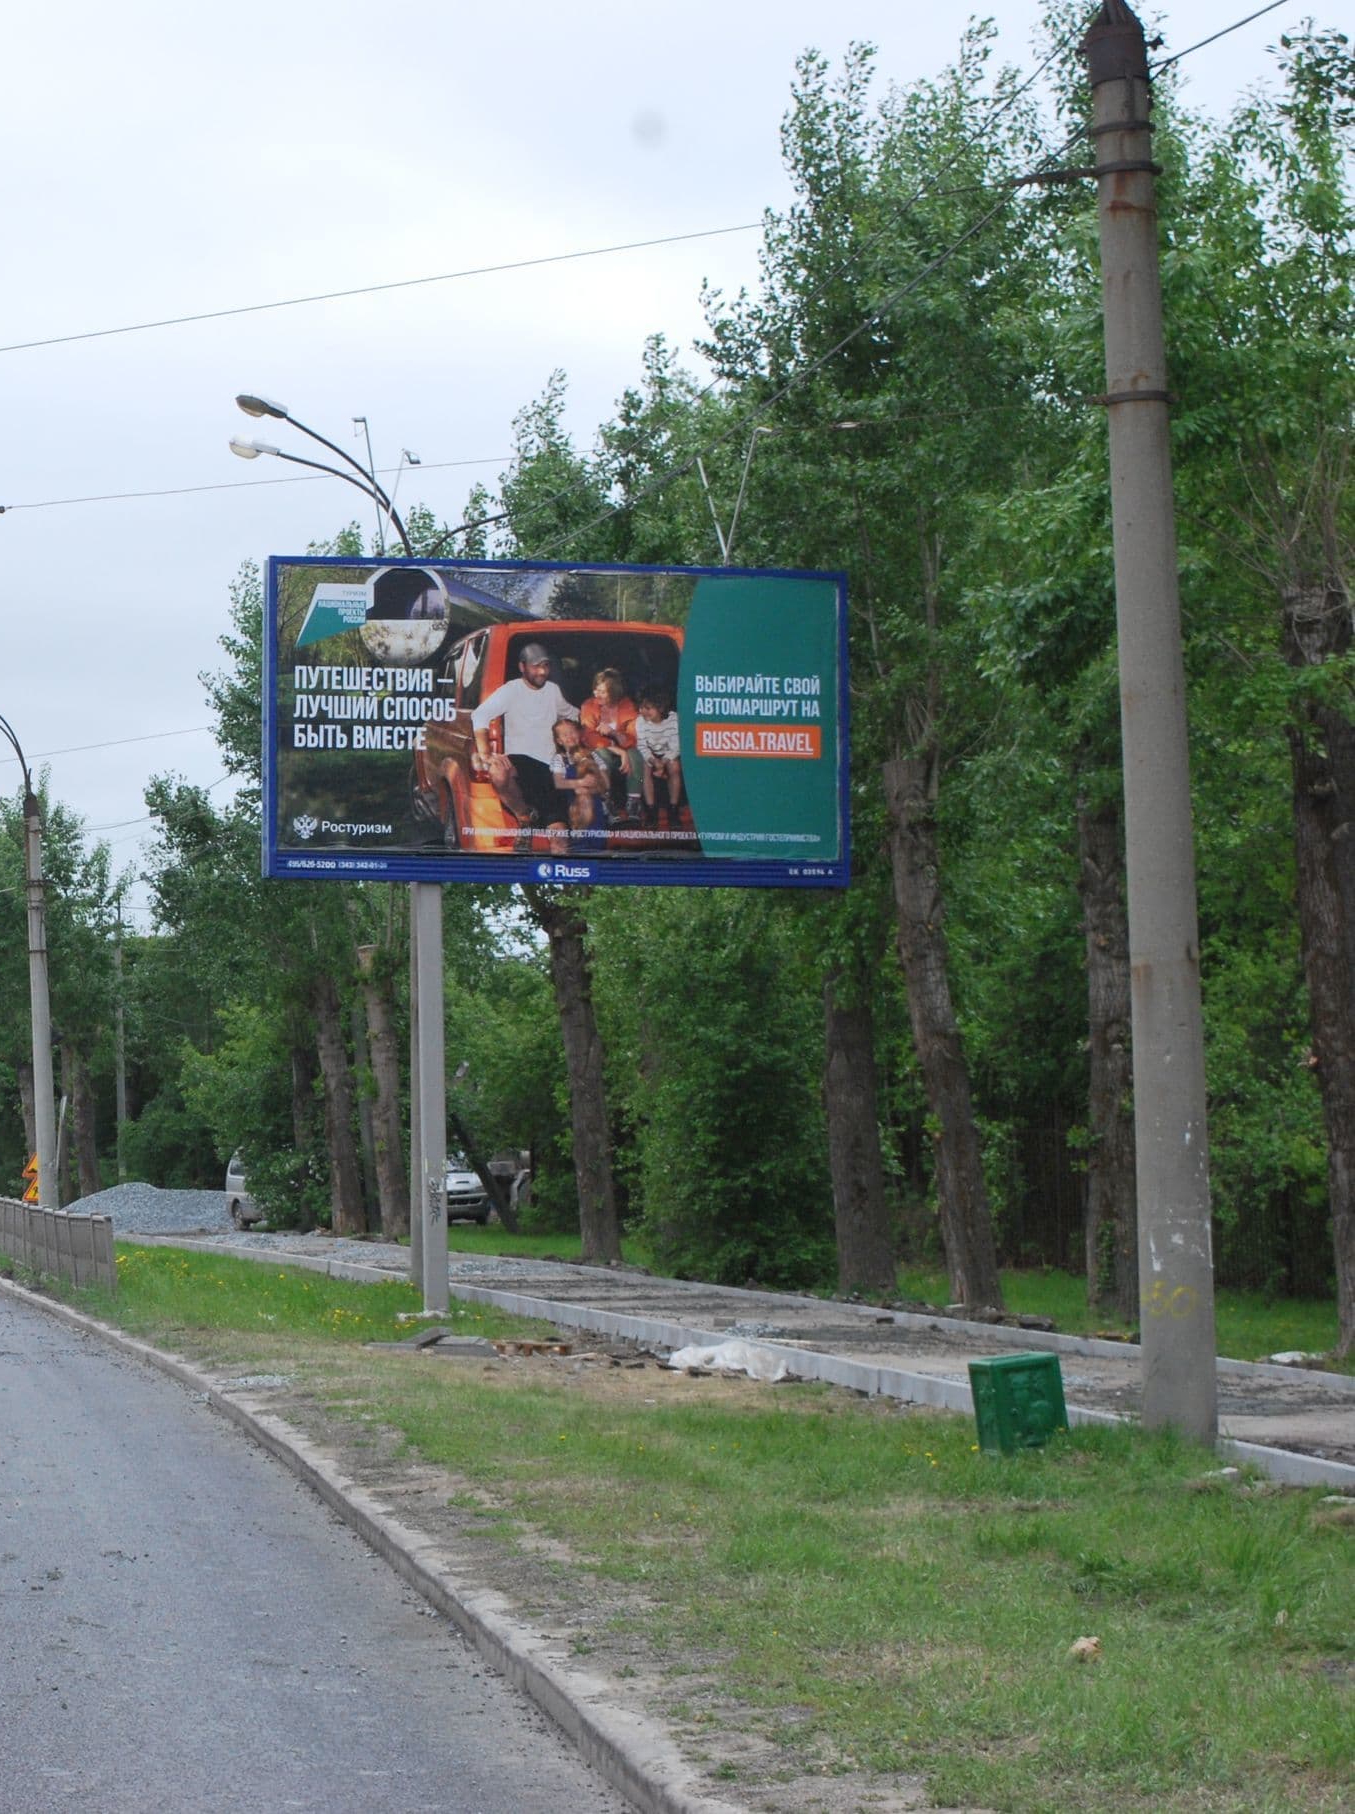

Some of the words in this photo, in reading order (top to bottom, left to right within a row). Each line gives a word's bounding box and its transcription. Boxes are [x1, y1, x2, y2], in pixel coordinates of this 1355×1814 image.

[294, 665, 433, 692] ПУТЕШЕСТВИЯ
[695, 674, 780, 694] ВЫБИРАЙТЕ
[783, 675, 820, 695] СВОЙ
[293, 691, 378, 720] ЛУЧШИЙ
[383, 697, 457, 722] СПОСОБ
[695, 697, 798, 717] АВТОМАРШРУТ
[801, 700, 820, 717] НА
[294, 724, 348, 749] БЫТЬ
[352, 725, 427, 750] ВМЕСТЕ
[702, 730, 813, 752] RUSSIA.TRAVEL
[321, 821, 392, 836] Ростуризм
[555, 864, 590, 877] Russ
